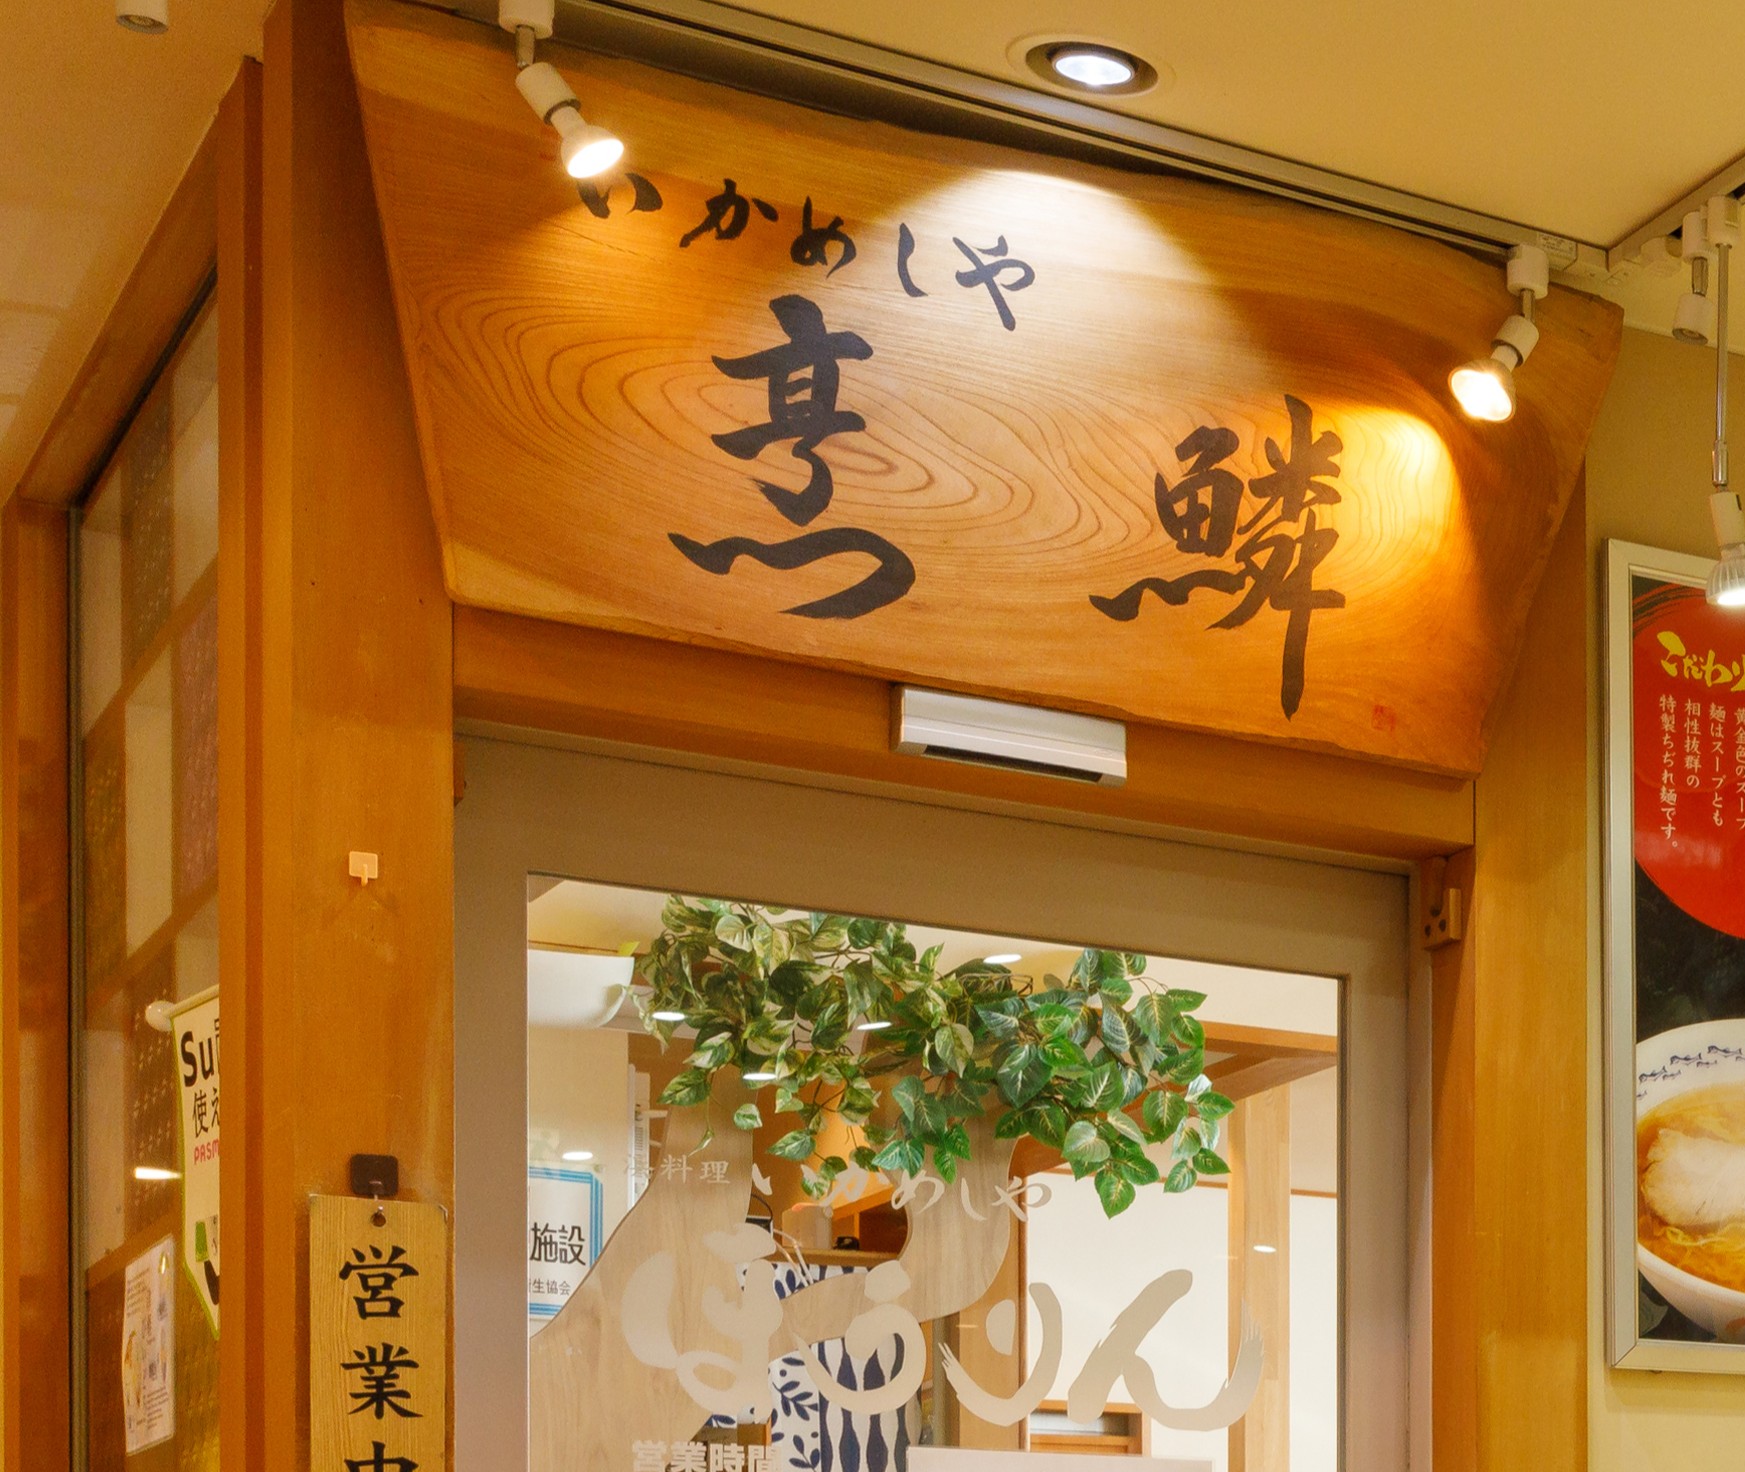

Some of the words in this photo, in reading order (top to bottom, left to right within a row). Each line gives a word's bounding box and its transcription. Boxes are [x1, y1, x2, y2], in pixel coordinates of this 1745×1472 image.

[576, 168, 1036, 332] いかめしや
[1683, 698, 1702, 788] 相性抜群の
[528, 1279, 571, 1297] 生協会
[621, 1221, 1266, 1432] ほうりん
